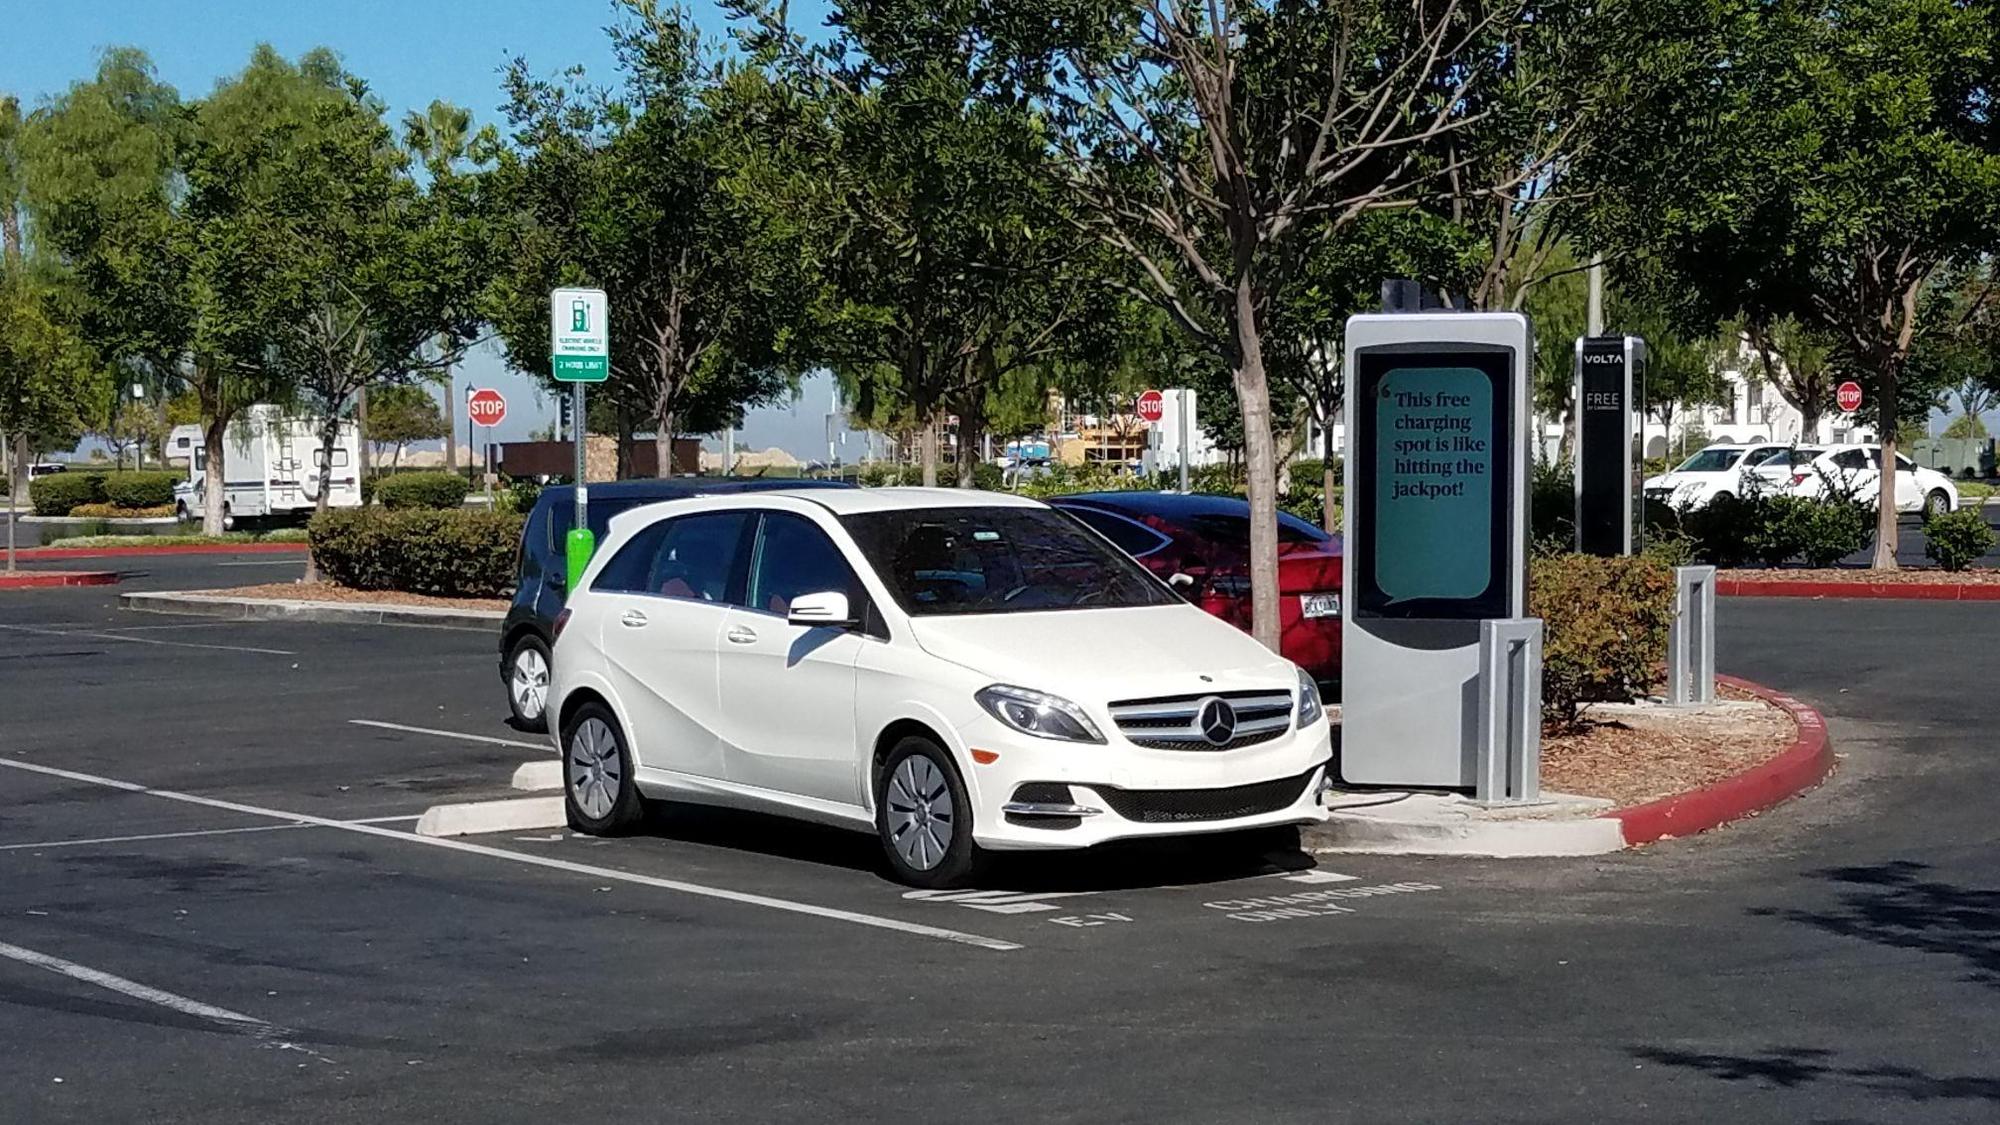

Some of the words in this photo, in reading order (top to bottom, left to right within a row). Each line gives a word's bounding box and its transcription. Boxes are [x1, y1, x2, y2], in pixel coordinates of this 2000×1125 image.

[559, 361, 564, 369] 2
[585, 361, 603, 369] LIMIT
[1584, 355, 1623, 363] VOLTA
[1436, 391, 1471, 407] free
[1587, 392, 1619, 405] FREE
[1840, 391, 1860, 402] STOP
[471, 400, 504, 415] STOP
[1394, 414, 1472, 433] charging
[1394, 438, 1433, 455] spot
[1435, 437, 1450, 452] is
[1453, 436, 1486, 452] like
[1394, 459, 1453, 477] hitting
[1456, 459, 1485, 474] the
[1392, 481, 1464, 500] jackpot!
